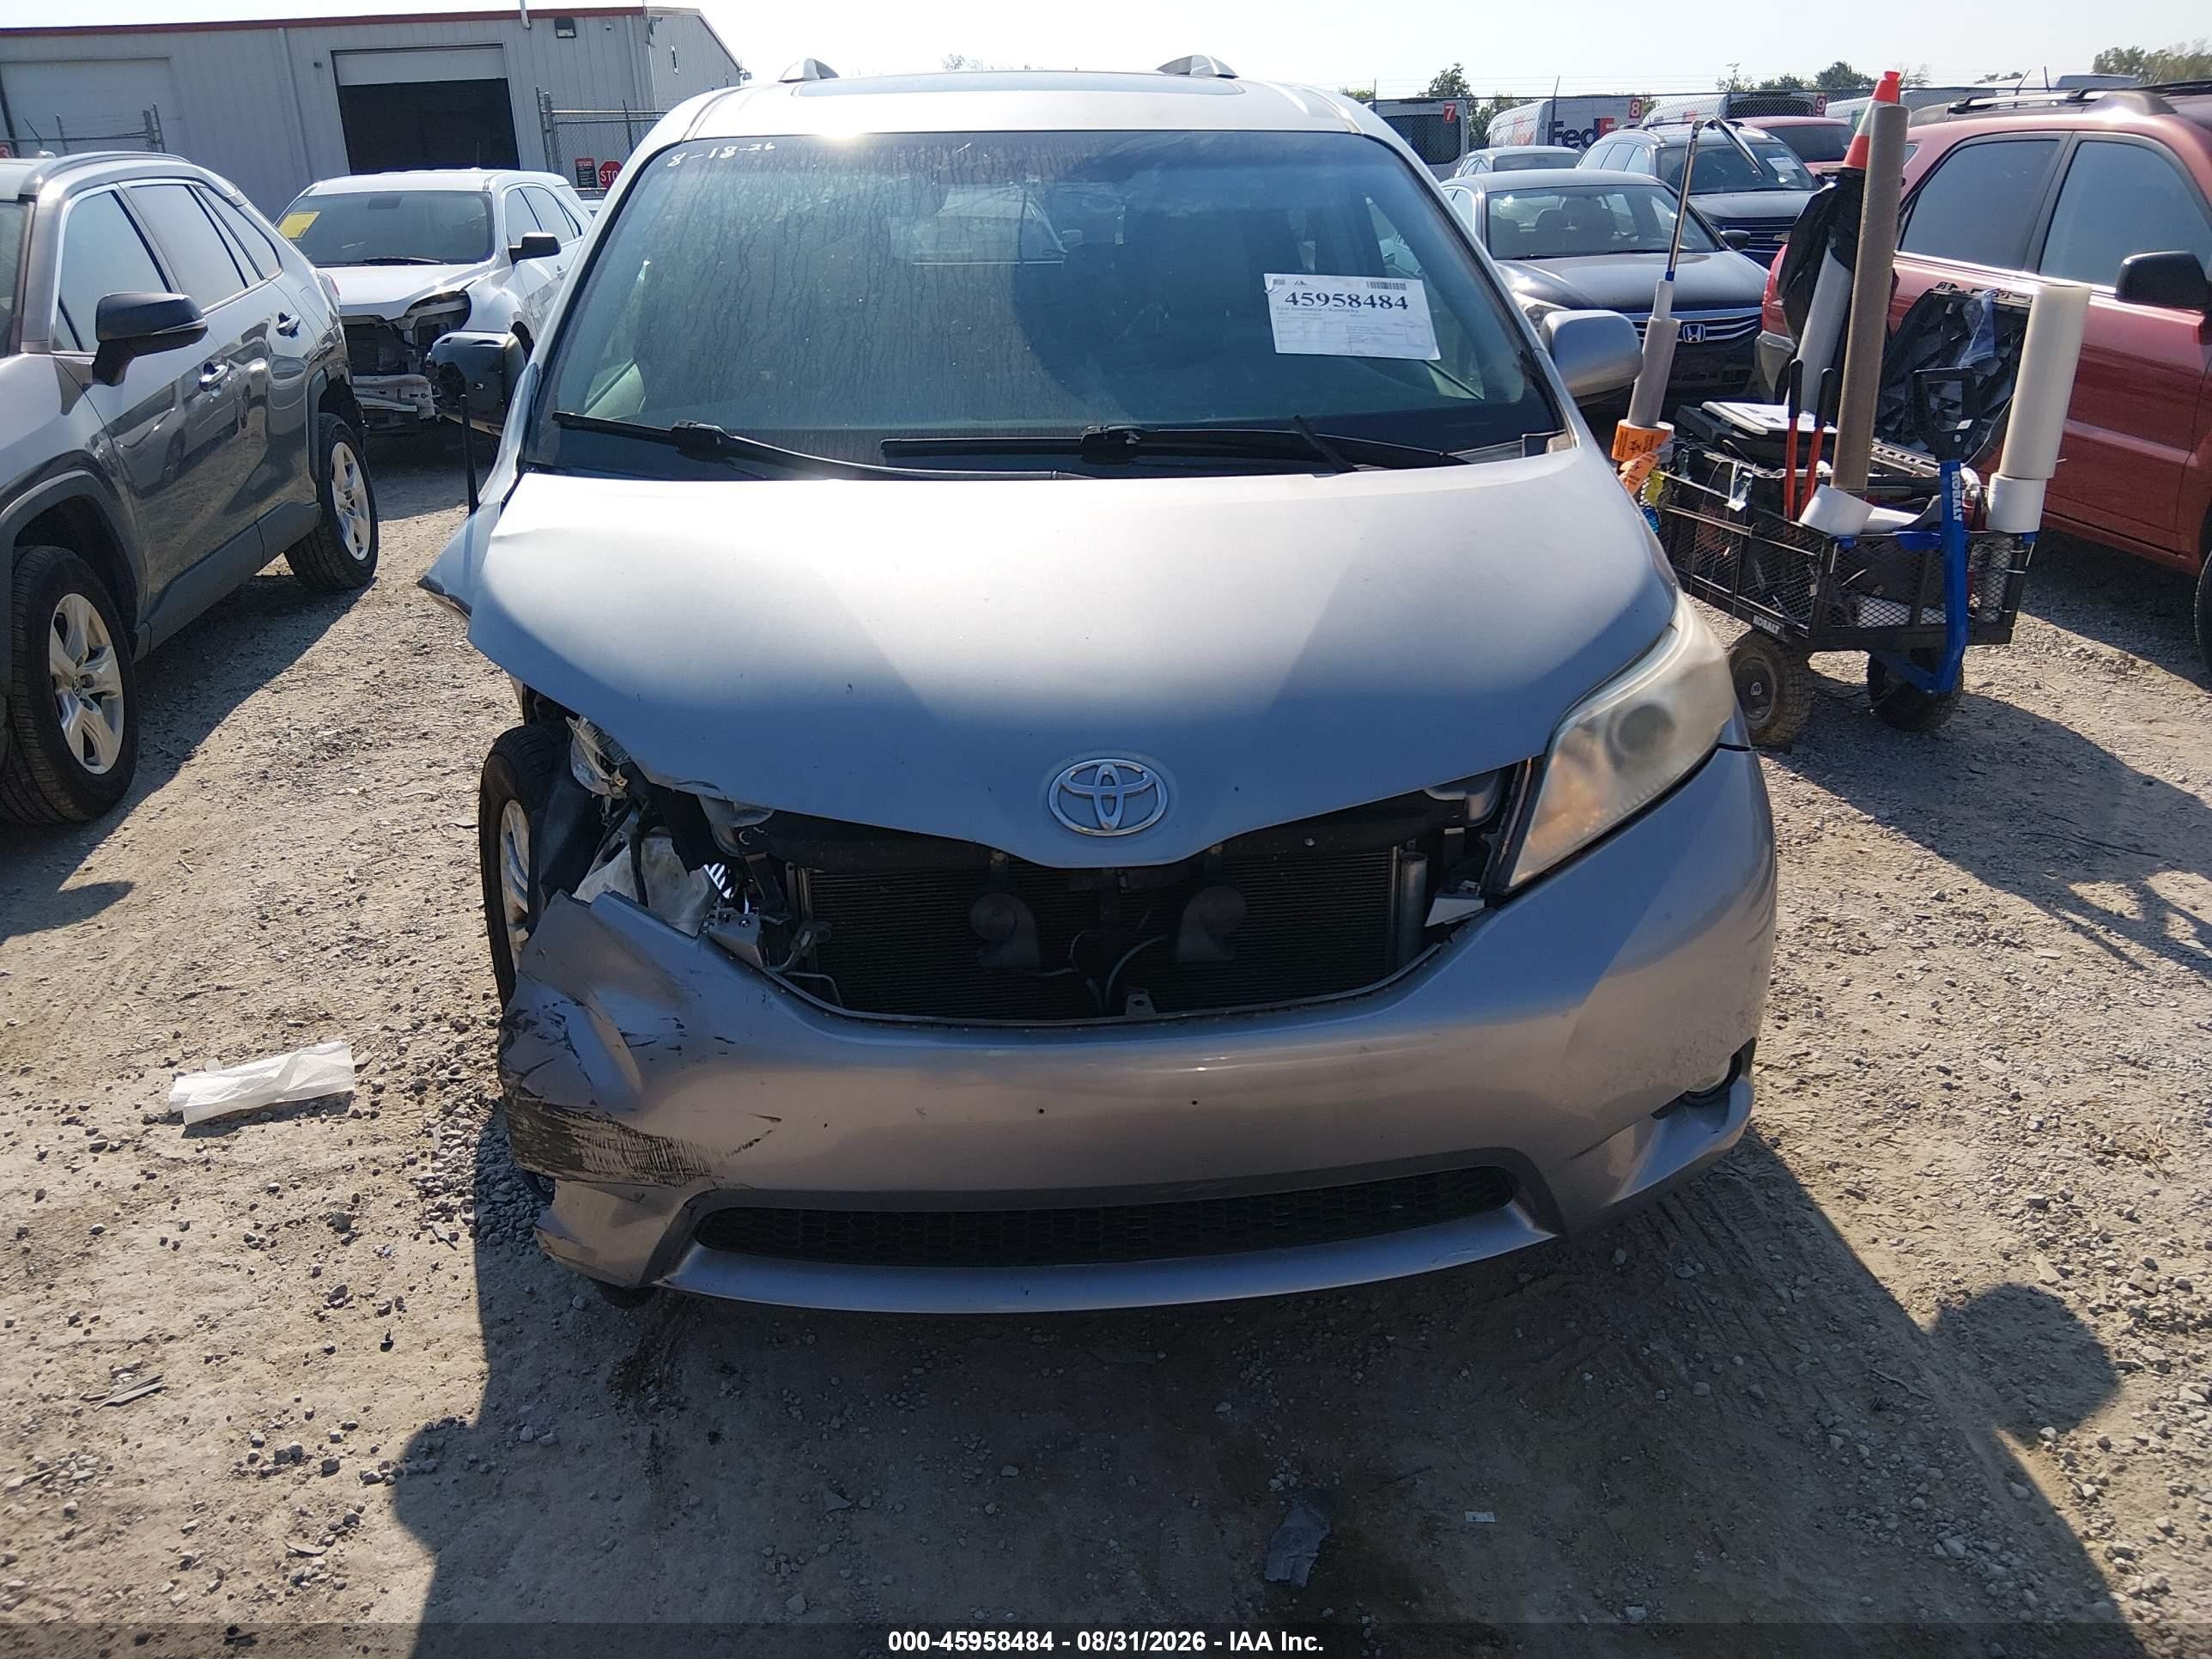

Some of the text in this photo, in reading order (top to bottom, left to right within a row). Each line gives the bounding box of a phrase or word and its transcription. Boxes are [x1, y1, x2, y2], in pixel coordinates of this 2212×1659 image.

[1445, 106, 1455, 120] 7
[1631, 101, 1640, 117] 8
[1816, 98, 1826, 112] 9
[1547, 117, 1615, 149] FedE
[667, 142, 776, 167] 8-18-26
[599, 170, 618, 182] STO
[1285, 291, 1409, 310] 45958484
[1951, 471, 1962, 522] KOBALT
[1753, 614, 1780, 635] KOBALT
